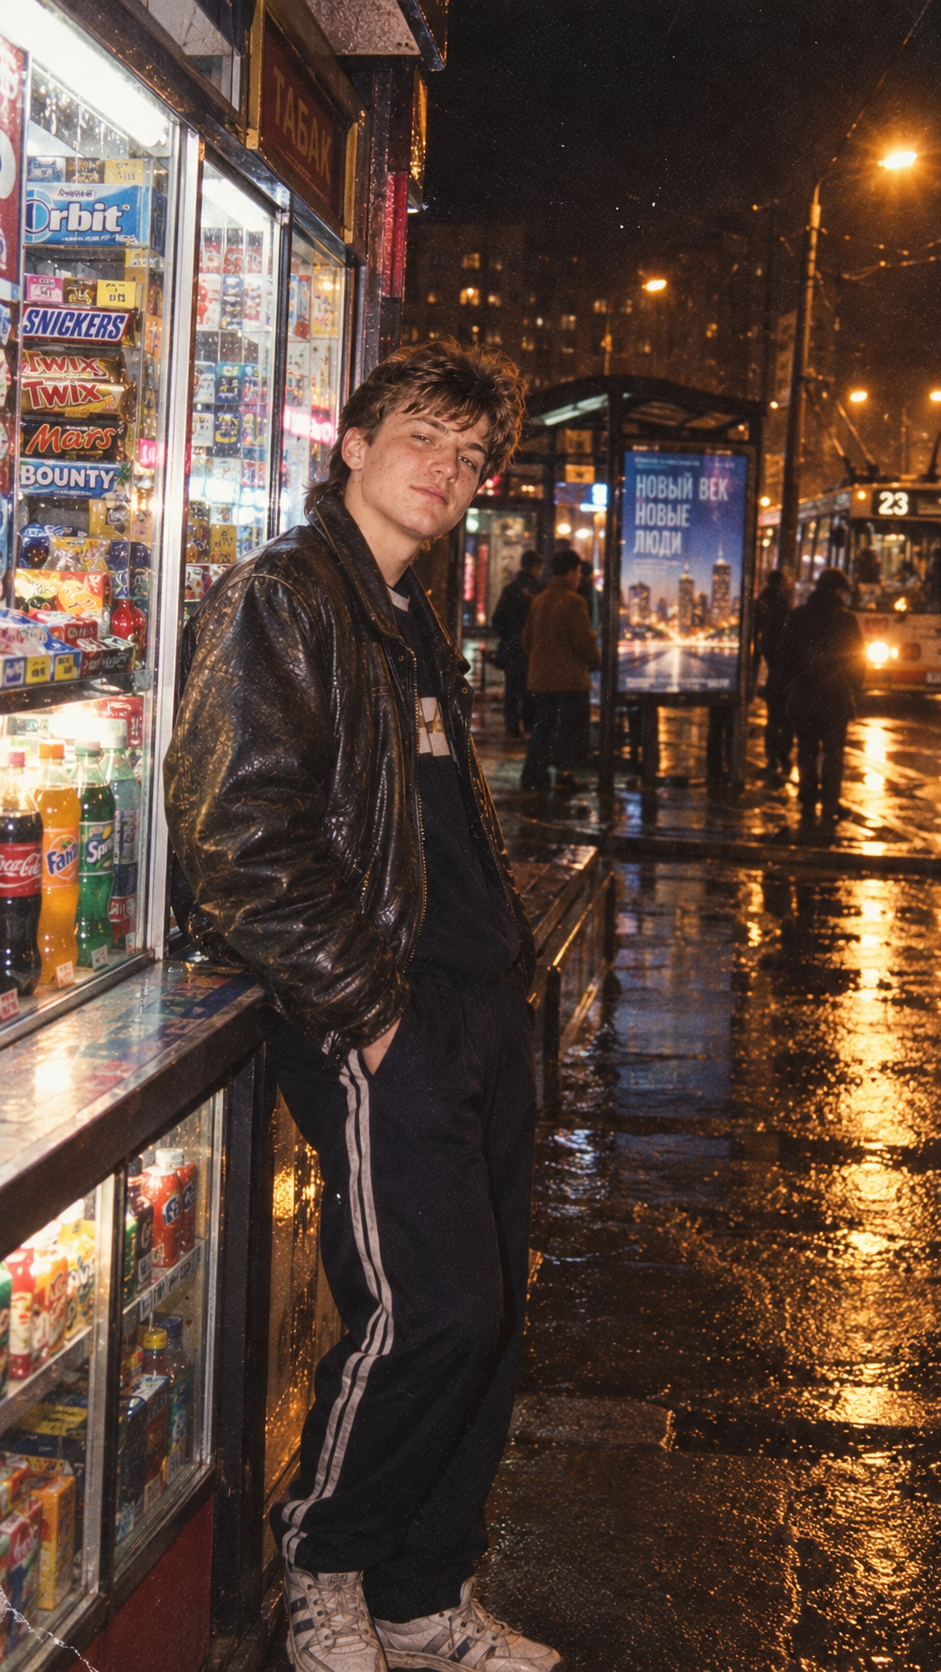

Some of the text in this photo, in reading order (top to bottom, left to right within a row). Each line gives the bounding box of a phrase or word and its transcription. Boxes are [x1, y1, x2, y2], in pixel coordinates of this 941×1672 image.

[273, 65, 332, 186] ТАБАК
[25, 199, 123, 234] Orbit
[22, 308, 127, 340] SNICKERS
[25, 423, 117, 455] Mars
[20, 465, 116, 489] BOUNTY
[635, 472, 729, 501] НОВЫЙ ВЕК
[635, 502, 691, 528] НОВЫЕ
[877, 490, 909, 516] 23
[633, 529, 682, 557] ЛЮДИ
